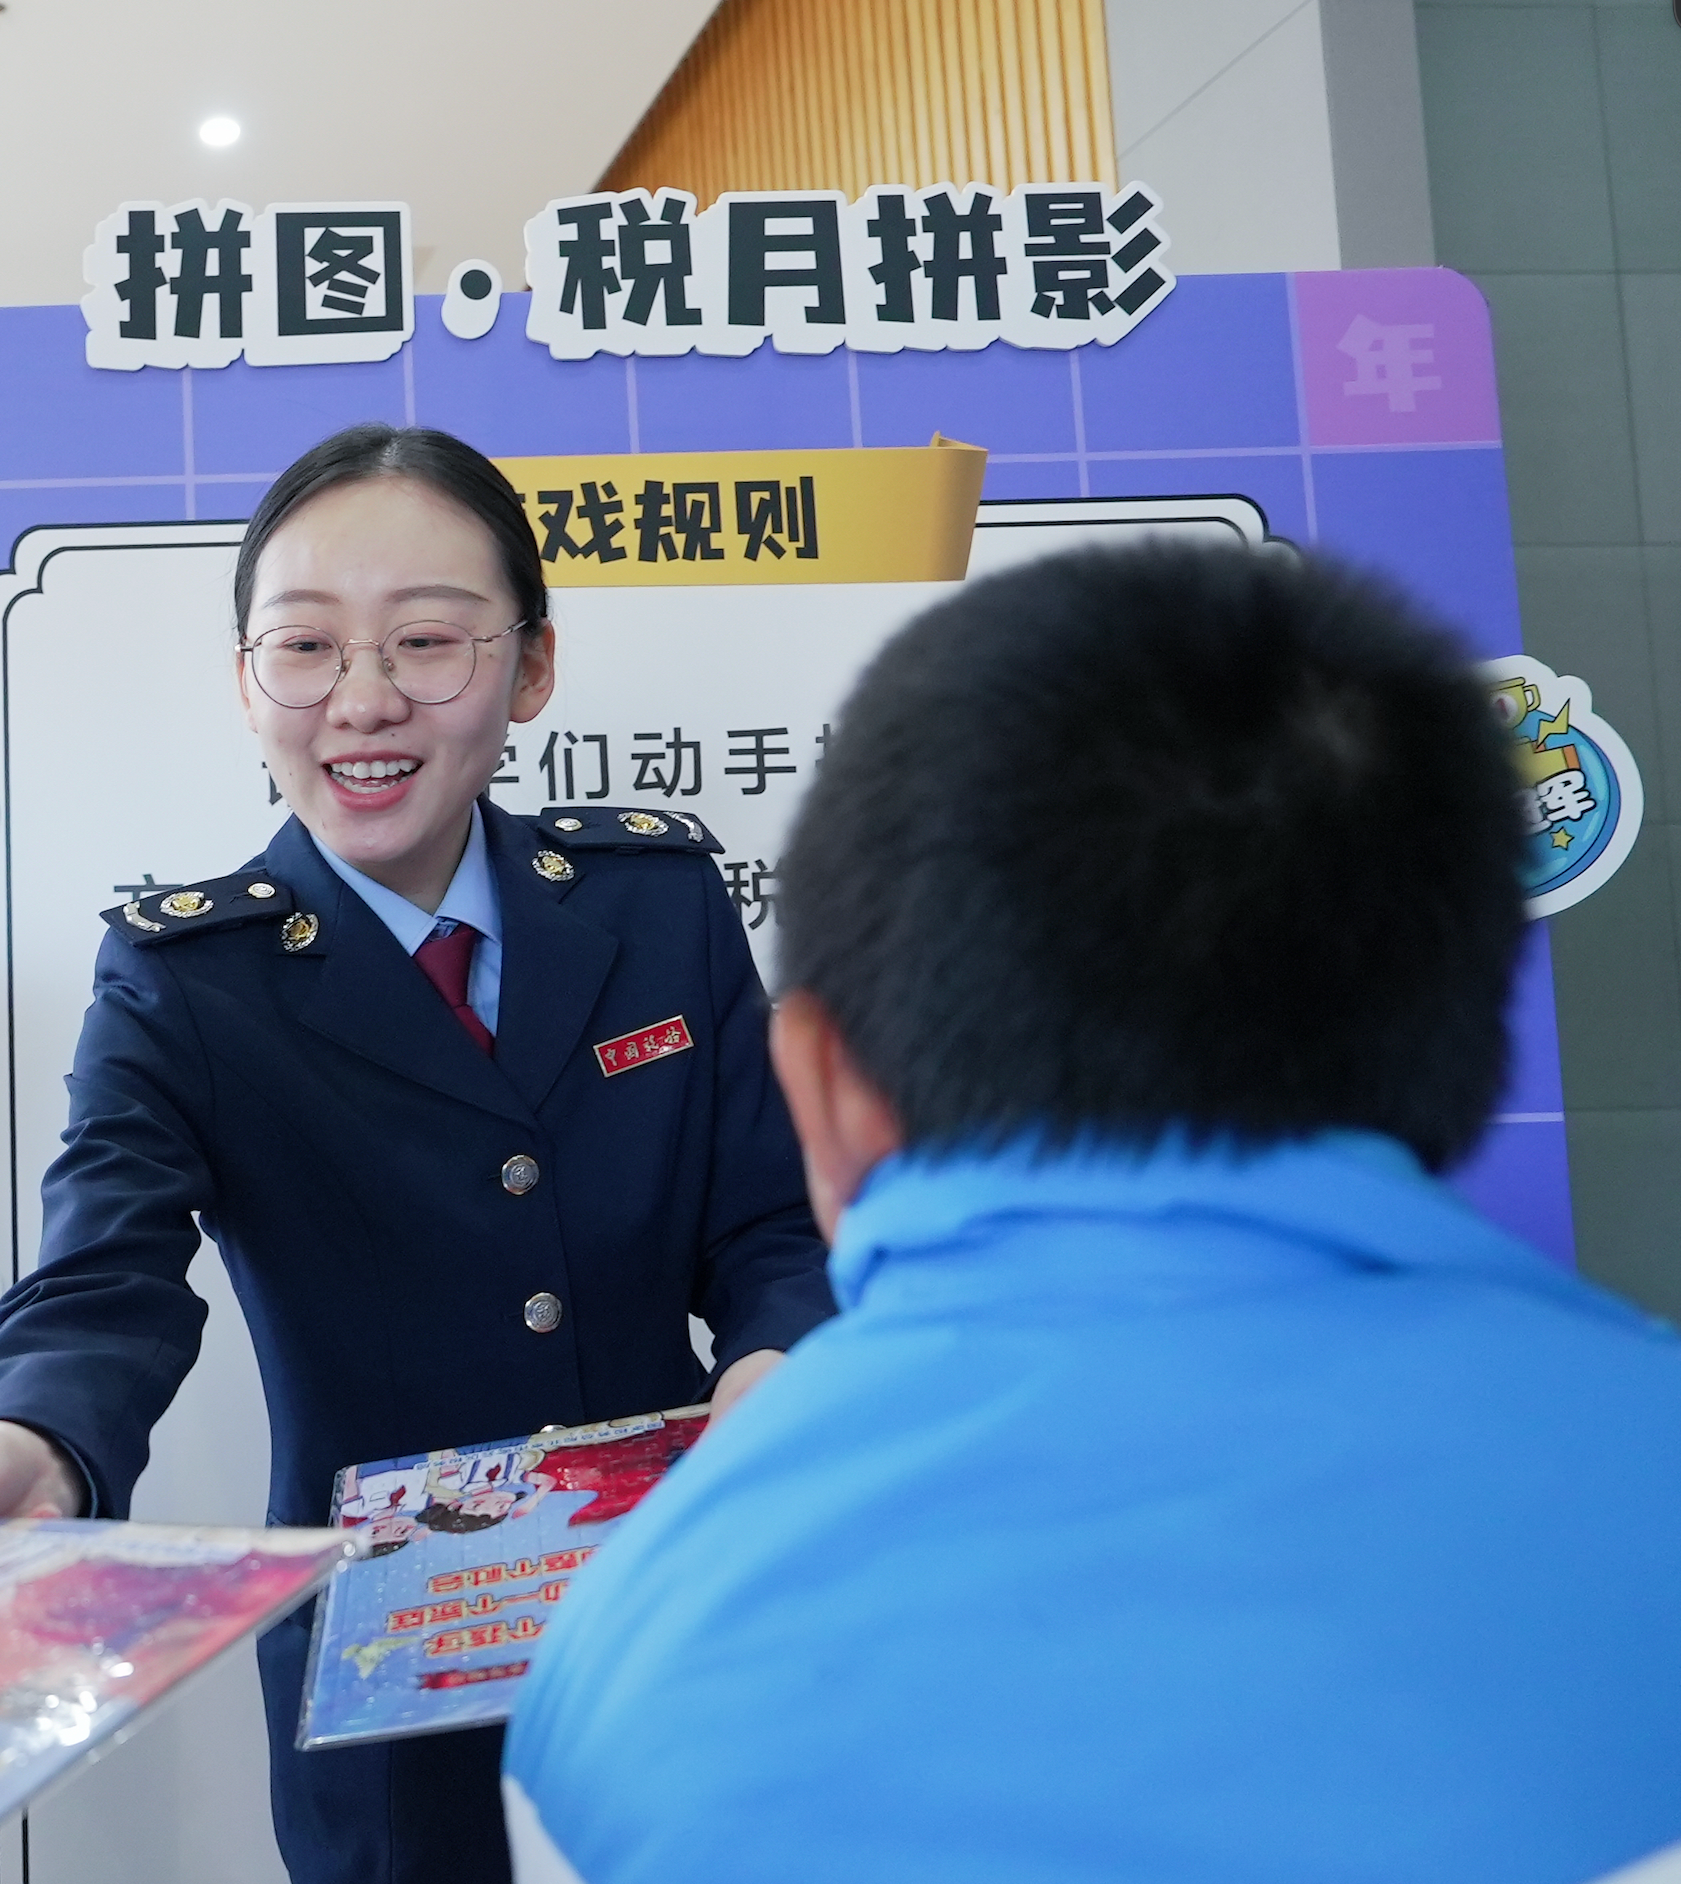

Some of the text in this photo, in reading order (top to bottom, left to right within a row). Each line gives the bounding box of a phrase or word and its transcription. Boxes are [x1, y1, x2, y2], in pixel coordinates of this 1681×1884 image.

[114, 190, 1167, 340] 拼图·税月拼影
[1336, 313, 1443, 413] 年
[518, 475, 819, 564] 戏规则
[489, 723, 831, 802] 们动手
